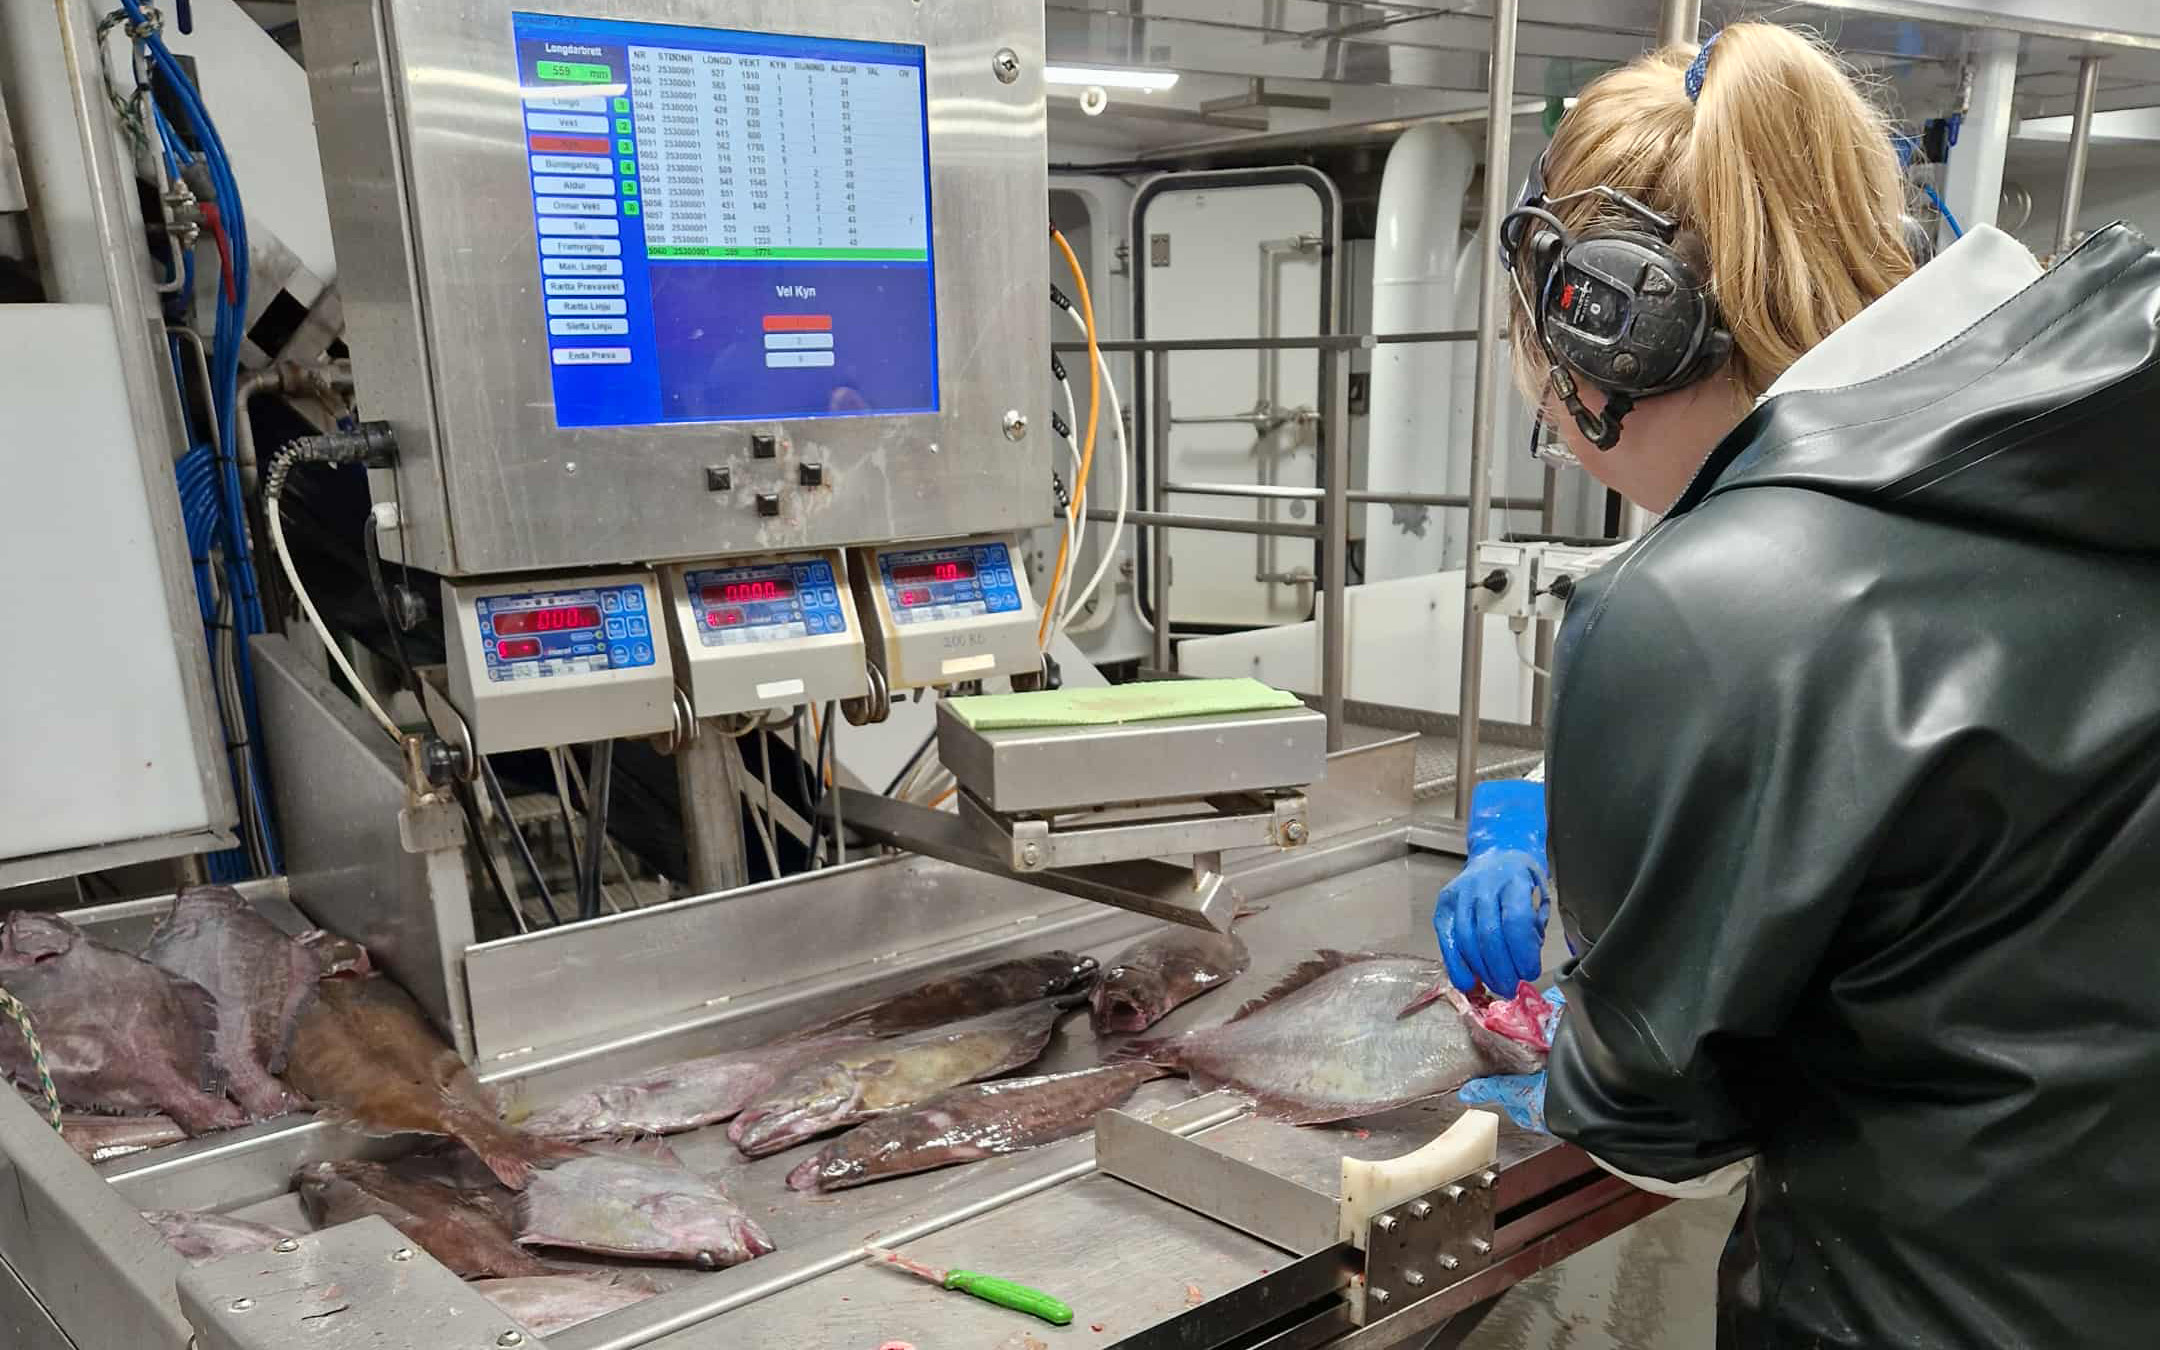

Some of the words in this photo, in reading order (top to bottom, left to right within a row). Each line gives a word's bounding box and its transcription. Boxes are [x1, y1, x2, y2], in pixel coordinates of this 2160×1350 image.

[552, 65, 571, 76] 559
[776, 285, 793, 298] Vel
[795, 285, 817, 300] Kyn
